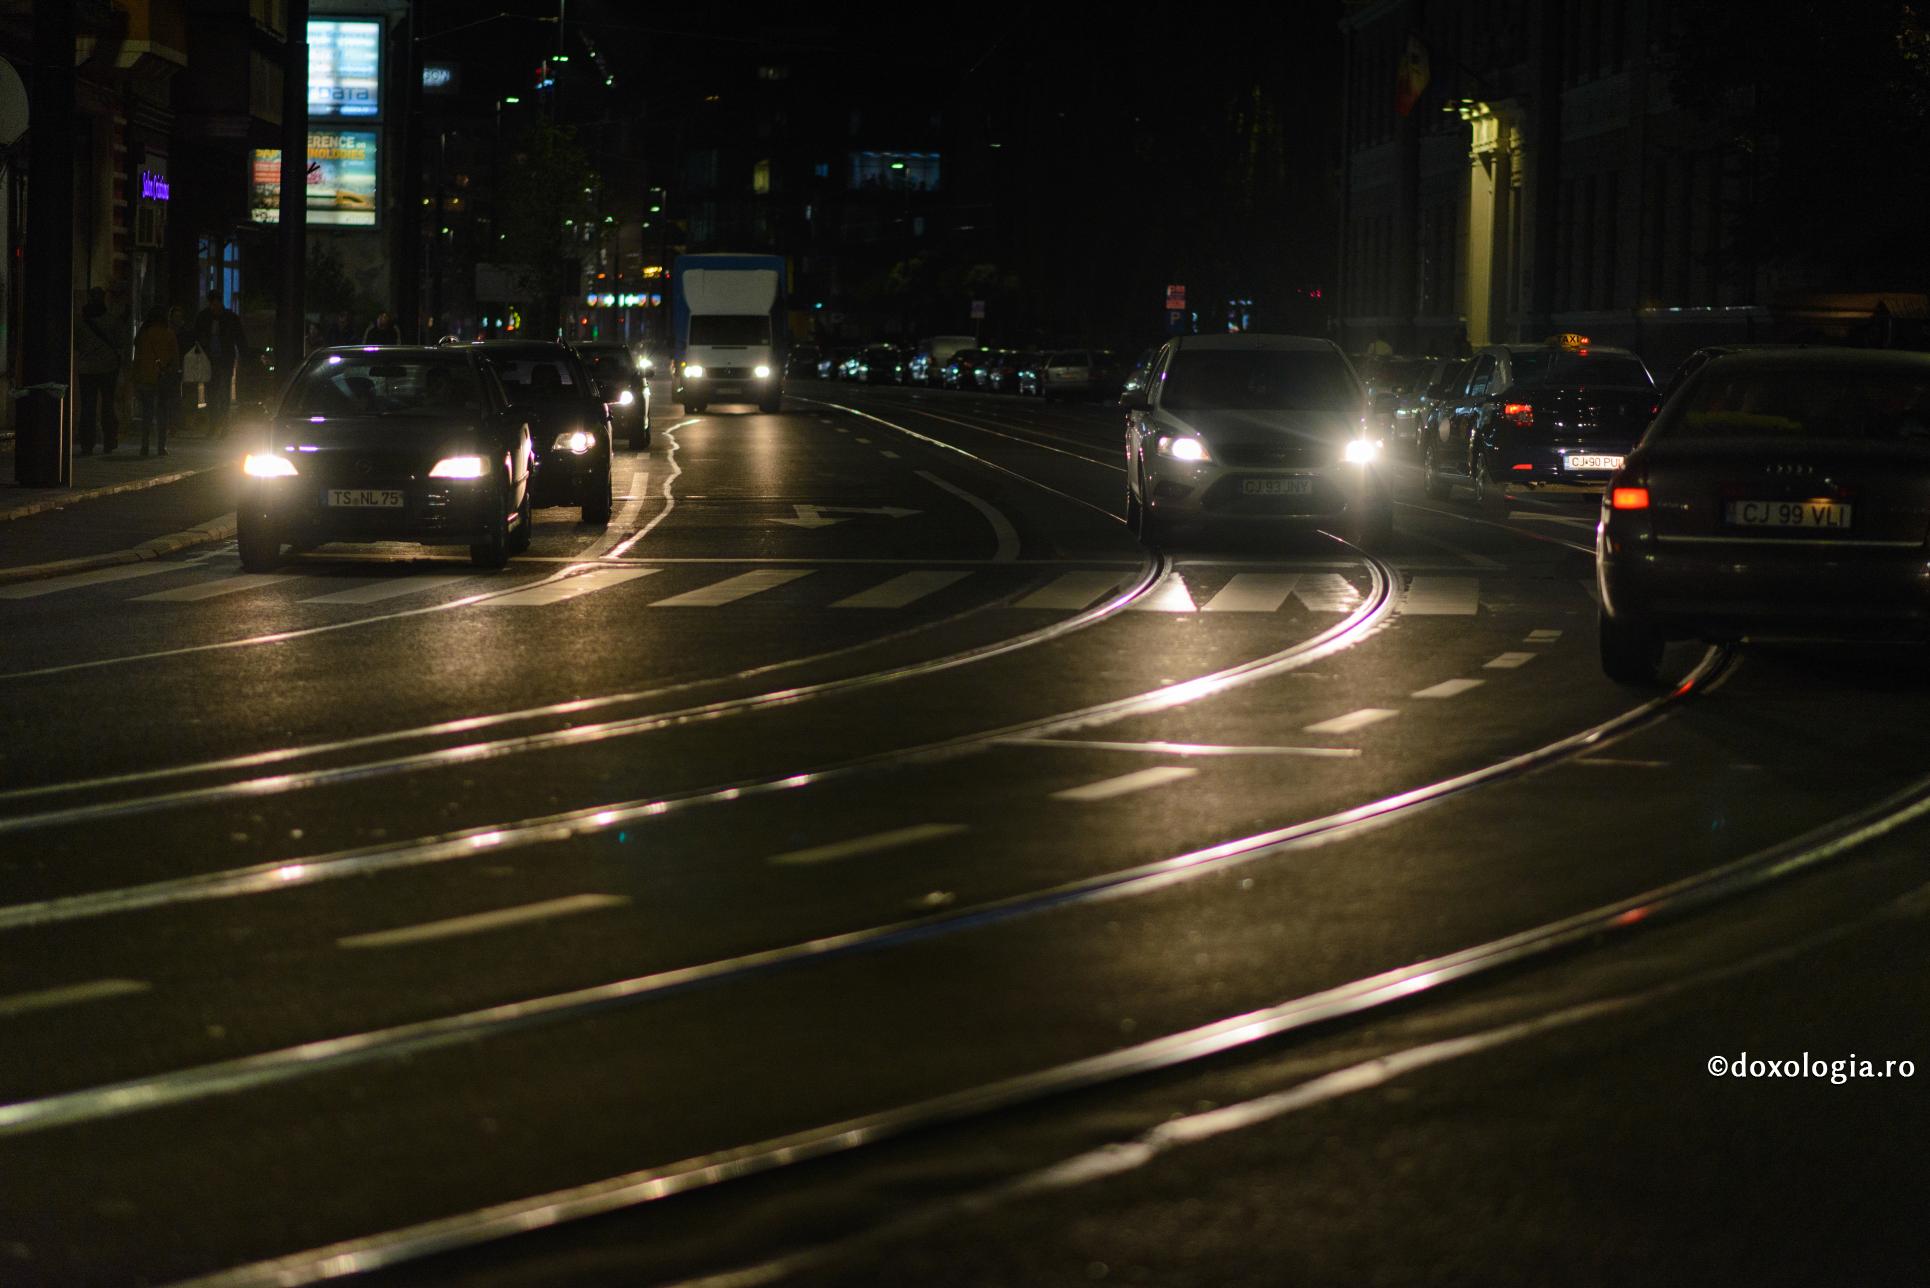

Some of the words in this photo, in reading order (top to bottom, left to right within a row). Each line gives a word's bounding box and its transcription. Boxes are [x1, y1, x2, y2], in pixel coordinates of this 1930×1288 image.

[308, 135, 355, 148] ERENCE
[1572, 457, 1585, 467] CJ
[1588, 457, 1601, 467] 90
[334, 491, 351, 505] TS
[360, 491, 378, 505] NL
[382, 491, 399, 505] 75
[1743, 502, 1770, 525] CJ
[1779, 503, 1803, 524] 99
[1811, 505, 1844, 526] VLI
